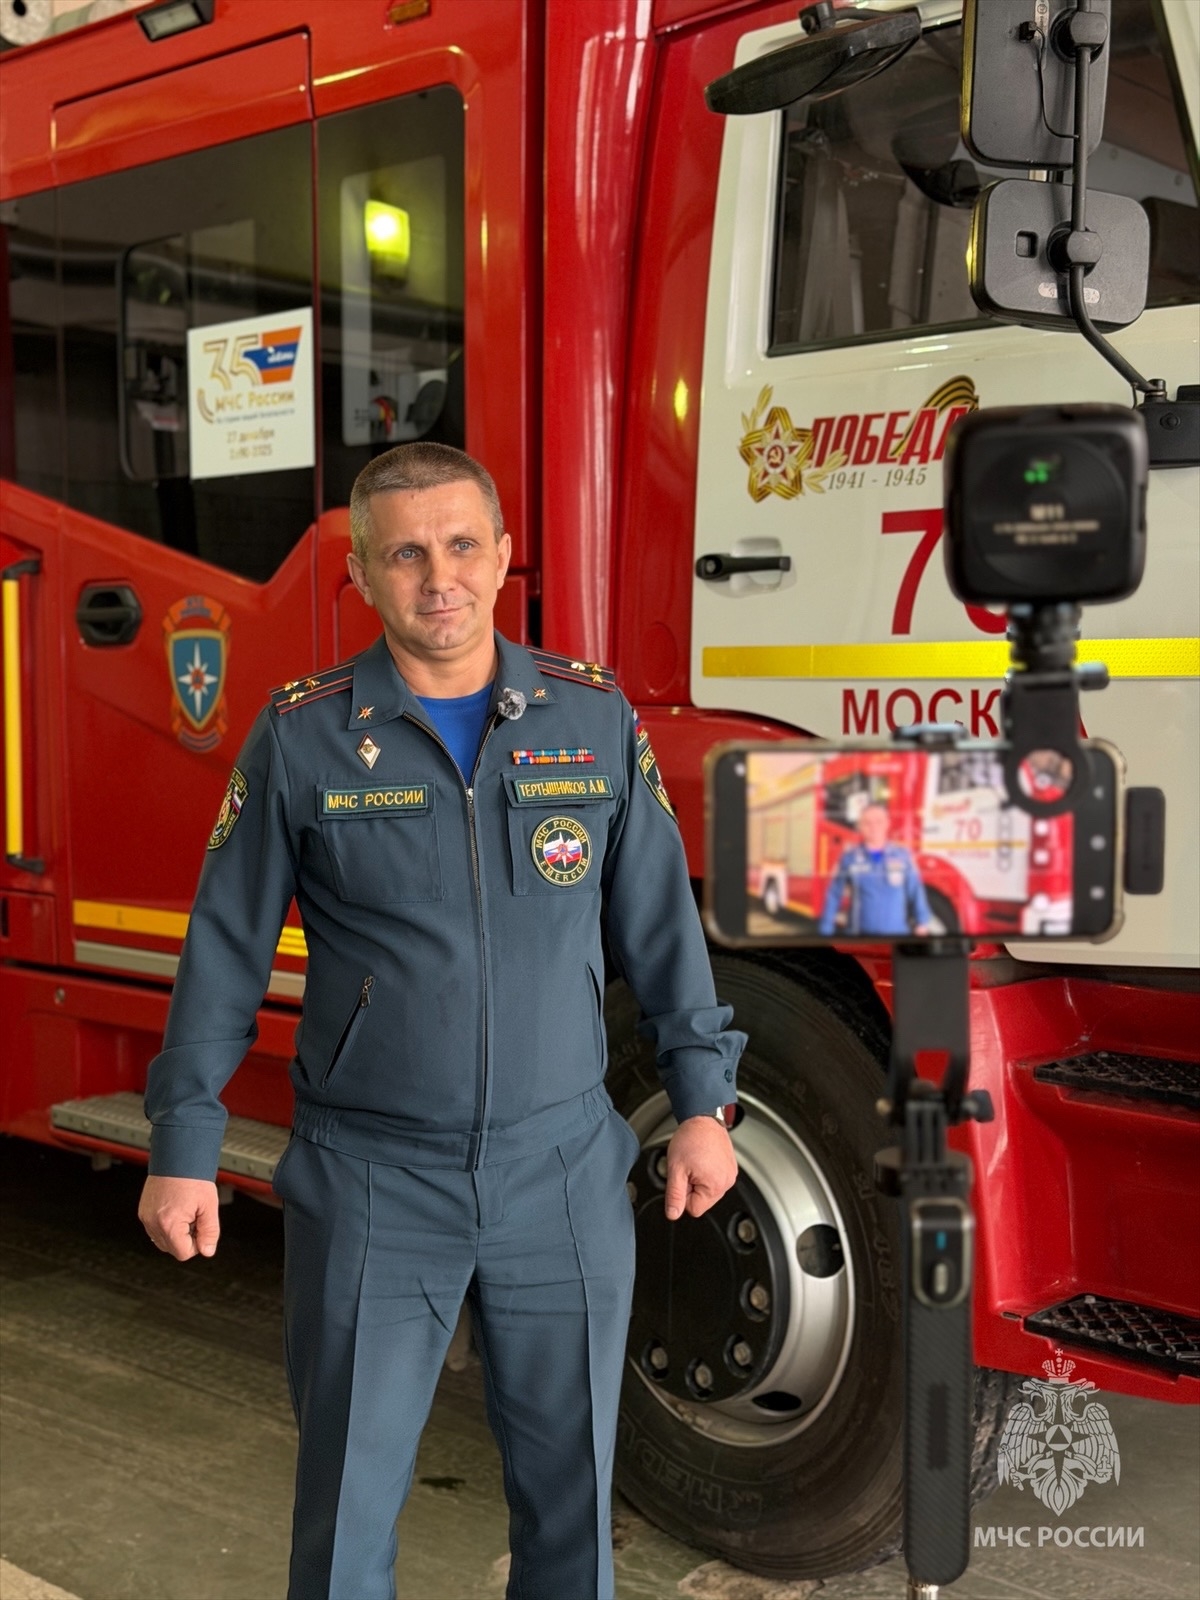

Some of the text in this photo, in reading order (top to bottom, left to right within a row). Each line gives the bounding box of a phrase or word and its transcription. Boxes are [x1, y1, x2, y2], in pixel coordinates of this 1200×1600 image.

[203, 334, 260, 390] 35
[215, 393, 242, 412] МЧС
[827, 473, 865, 490] 1941
[885, 468, 927, 487] 1945
[328, 789, 424, 809] МЧС РОССИИ
[519, 779, 609, 798] ТЕРТЫШНИКОВ А.М.
[535, 820, 587, 849] МЧС РОССИИ
[540, 857, 589, 882] EMERCOM
